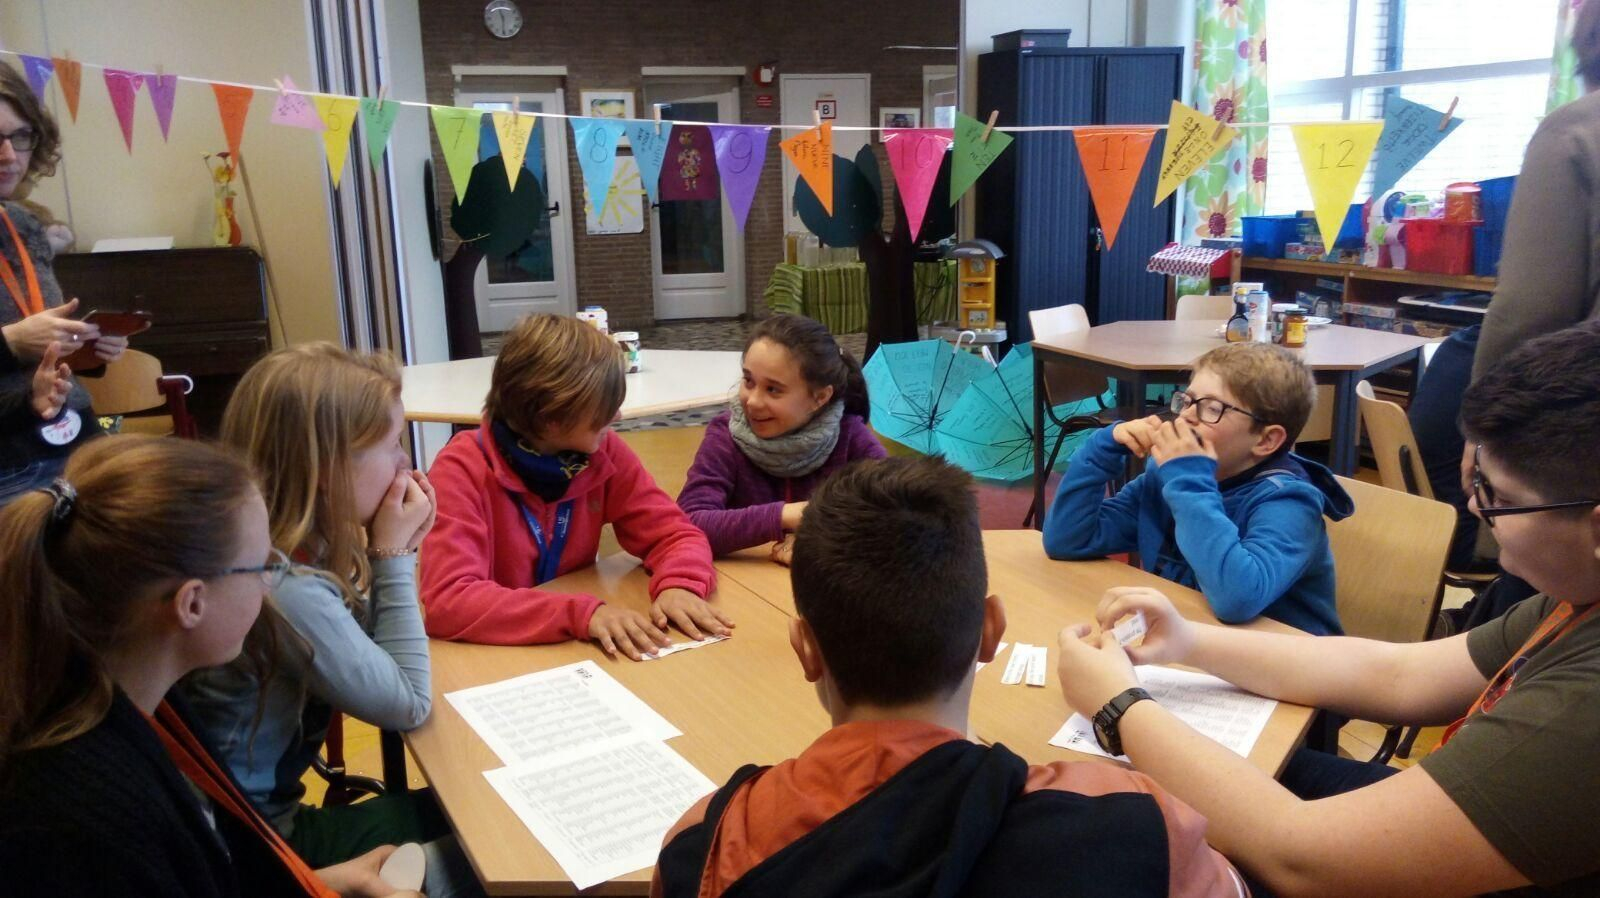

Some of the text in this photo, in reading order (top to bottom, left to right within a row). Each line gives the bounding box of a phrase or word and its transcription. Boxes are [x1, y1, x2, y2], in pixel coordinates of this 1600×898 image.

[326, 98, 342, 133] 6
[822, 104, 830, 115] B
[448, 117, 467, 150] 7
[590, 127, 608, 163] 8
[729, 131, 752, 174] 9
[901, 134, 934, 170] 10
[1097, 136, 1129, 171] 11
[1174, 141, 1215, 181] ELEVEN
[1318, 139, 1355, 170] 12
